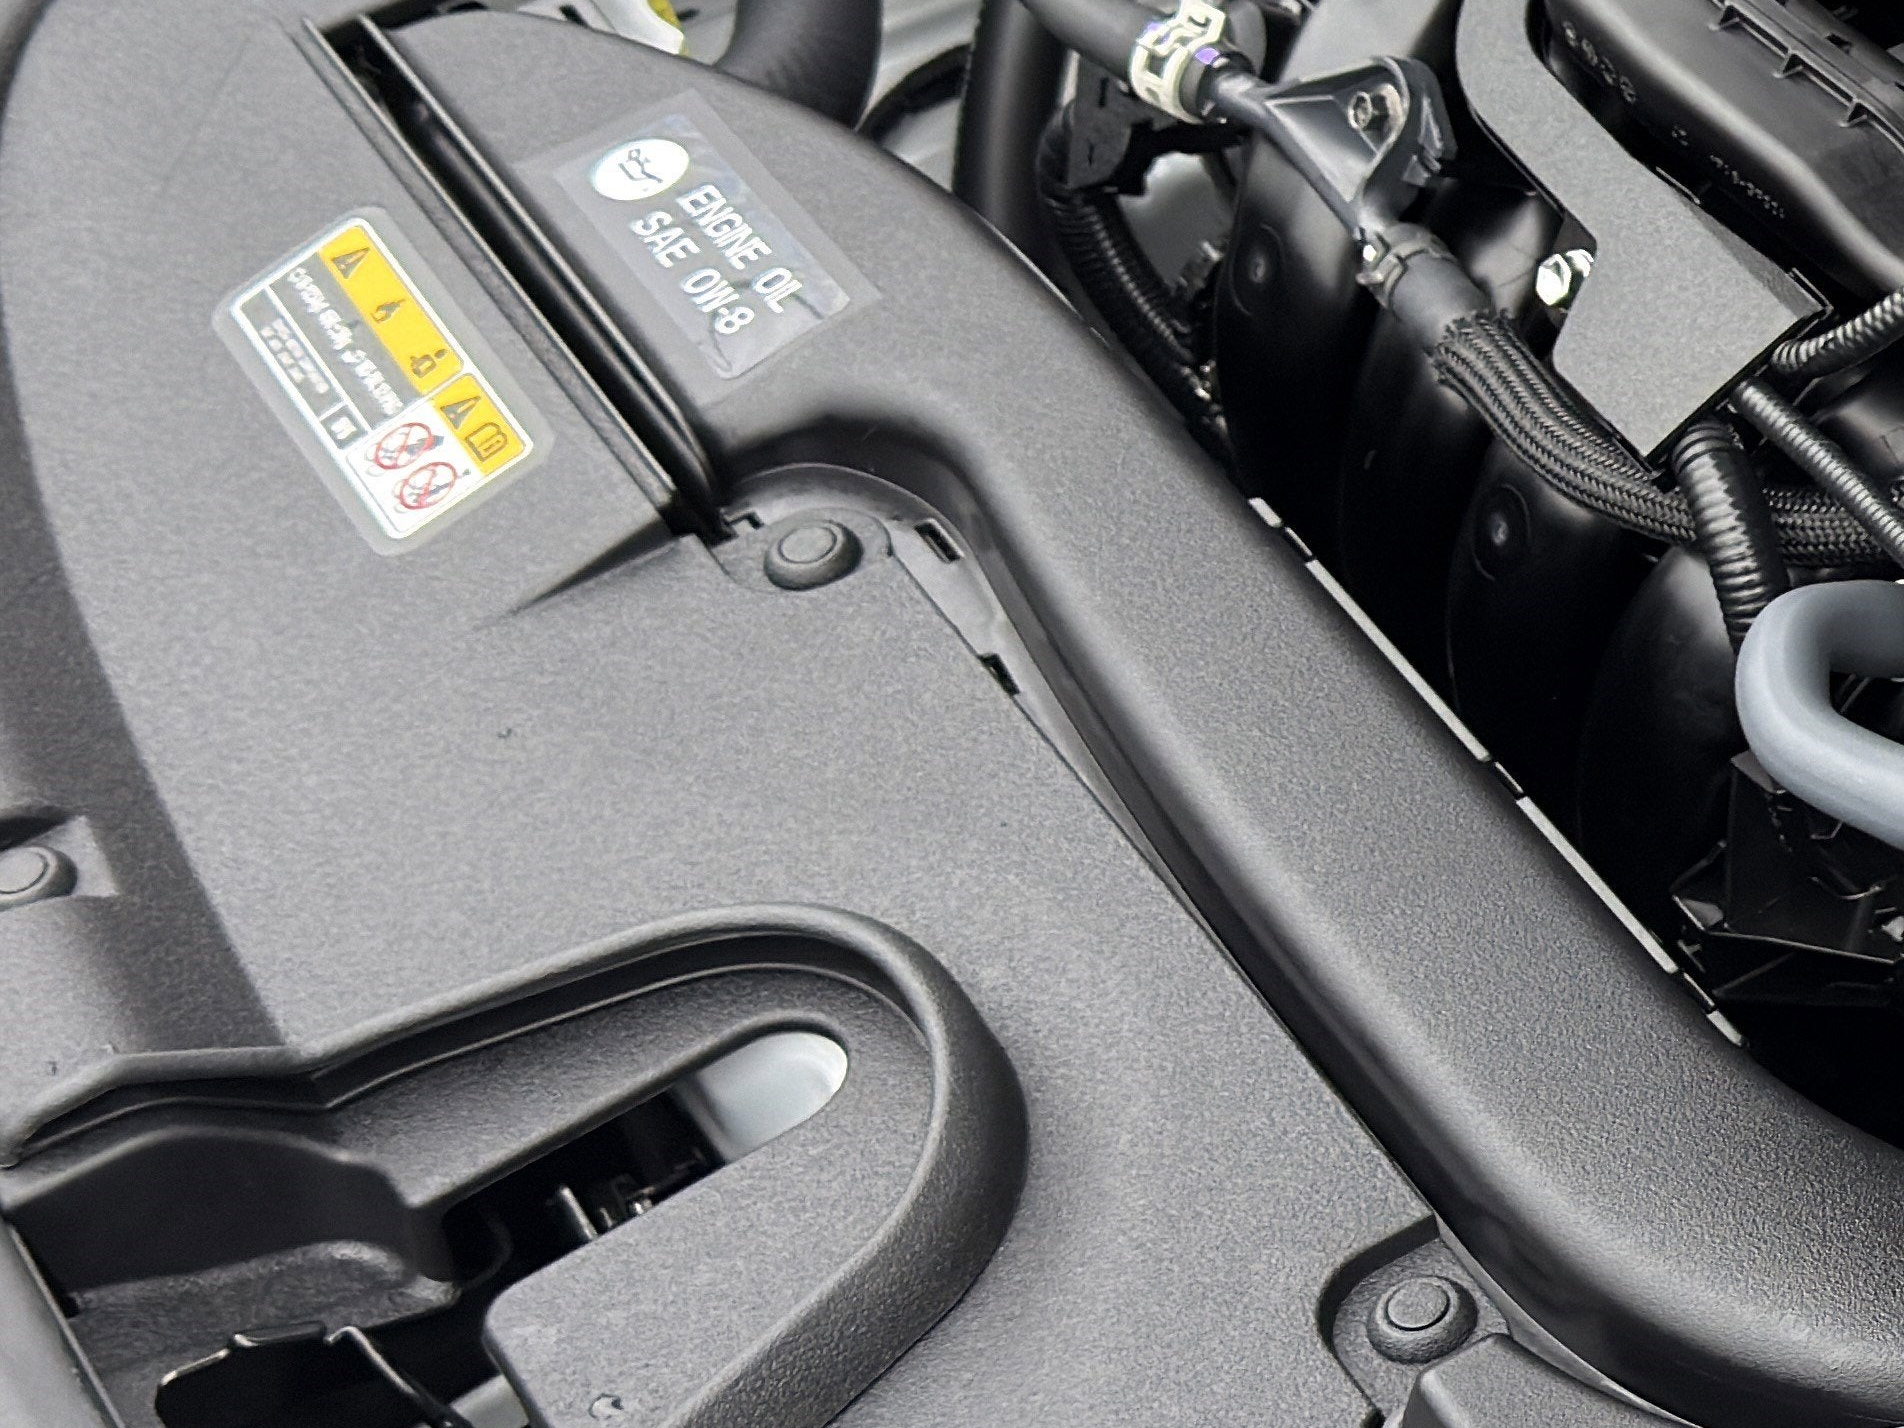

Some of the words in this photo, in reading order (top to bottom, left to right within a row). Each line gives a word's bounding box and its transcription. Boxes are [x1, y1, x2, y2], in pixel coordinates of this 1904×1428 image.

[628, 210, 700, 268] SAE
[675, 184, 772, 270] ENGINE
[751, 267, 803, 314] OIL
